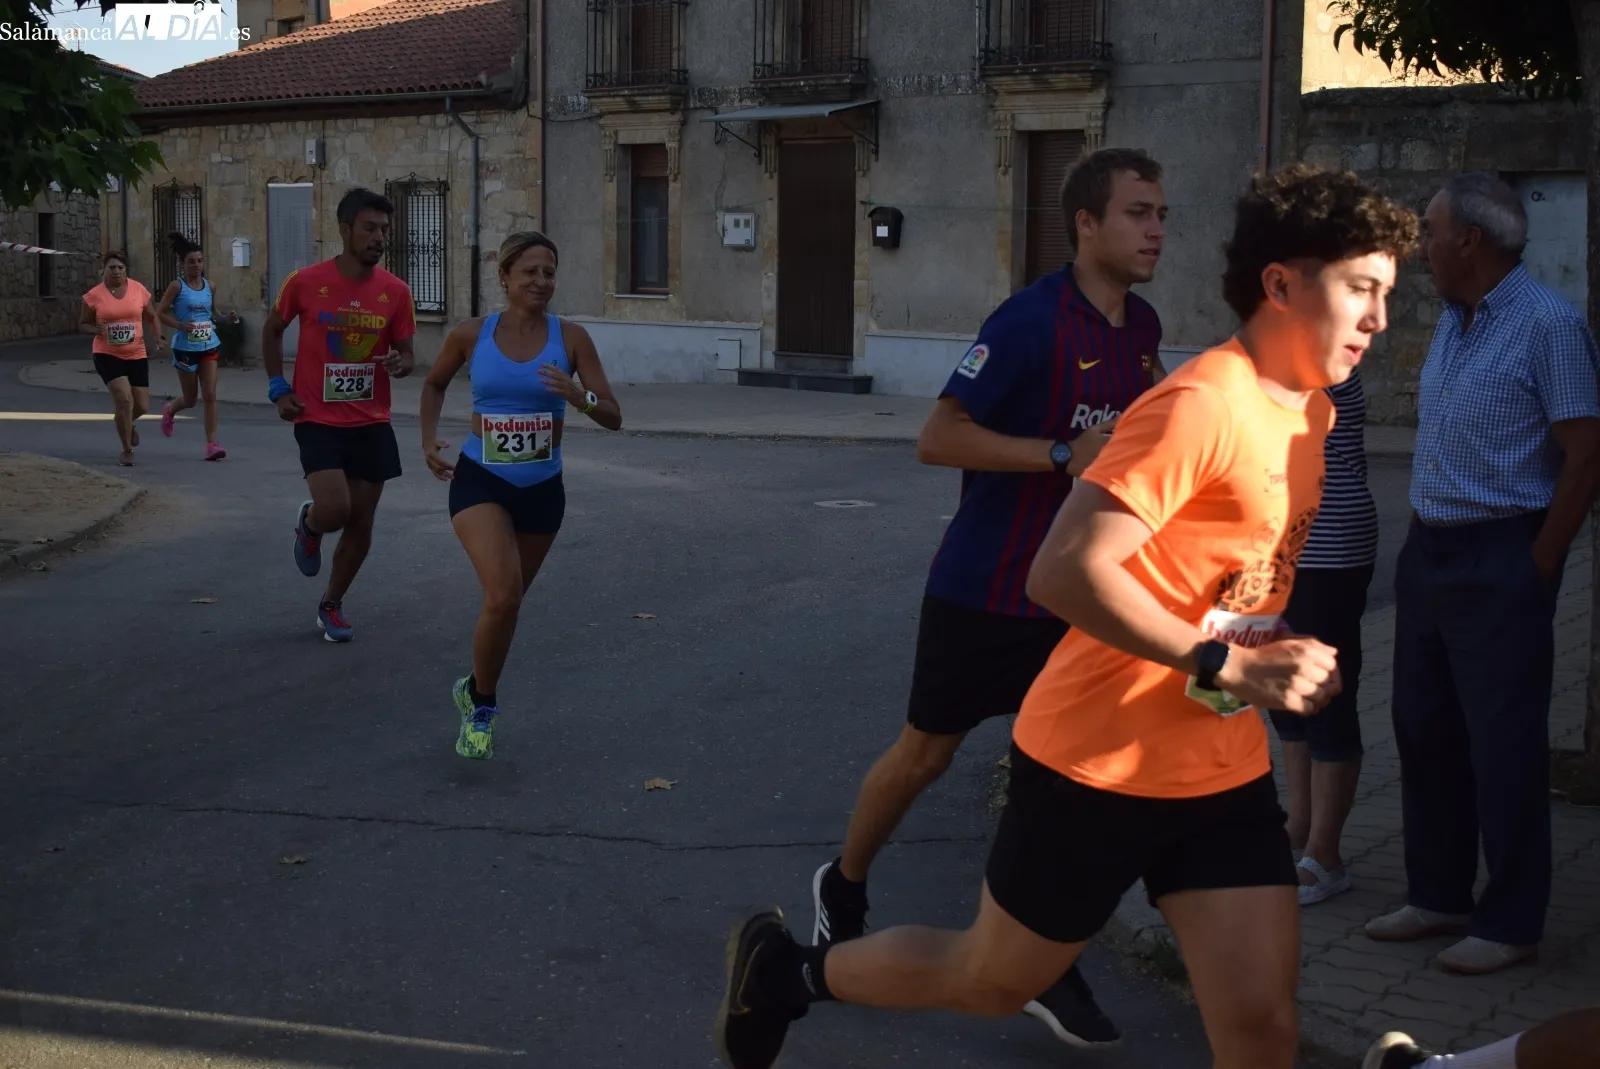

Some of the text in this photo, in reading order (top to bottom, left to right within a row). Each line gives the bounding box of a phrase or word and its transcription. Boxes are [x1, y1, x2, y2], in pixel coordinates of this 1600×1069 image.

[318, 311, 387, 329] MADRID
[112, 331, 131, 340] 207
[194, 329, 209, 338] 224
[347, 332, 360, 342] 42
[335, 377, 365, 393] 228
[483, 414, 552, 433] bedunia
[496, 432, 537, 453] 231
